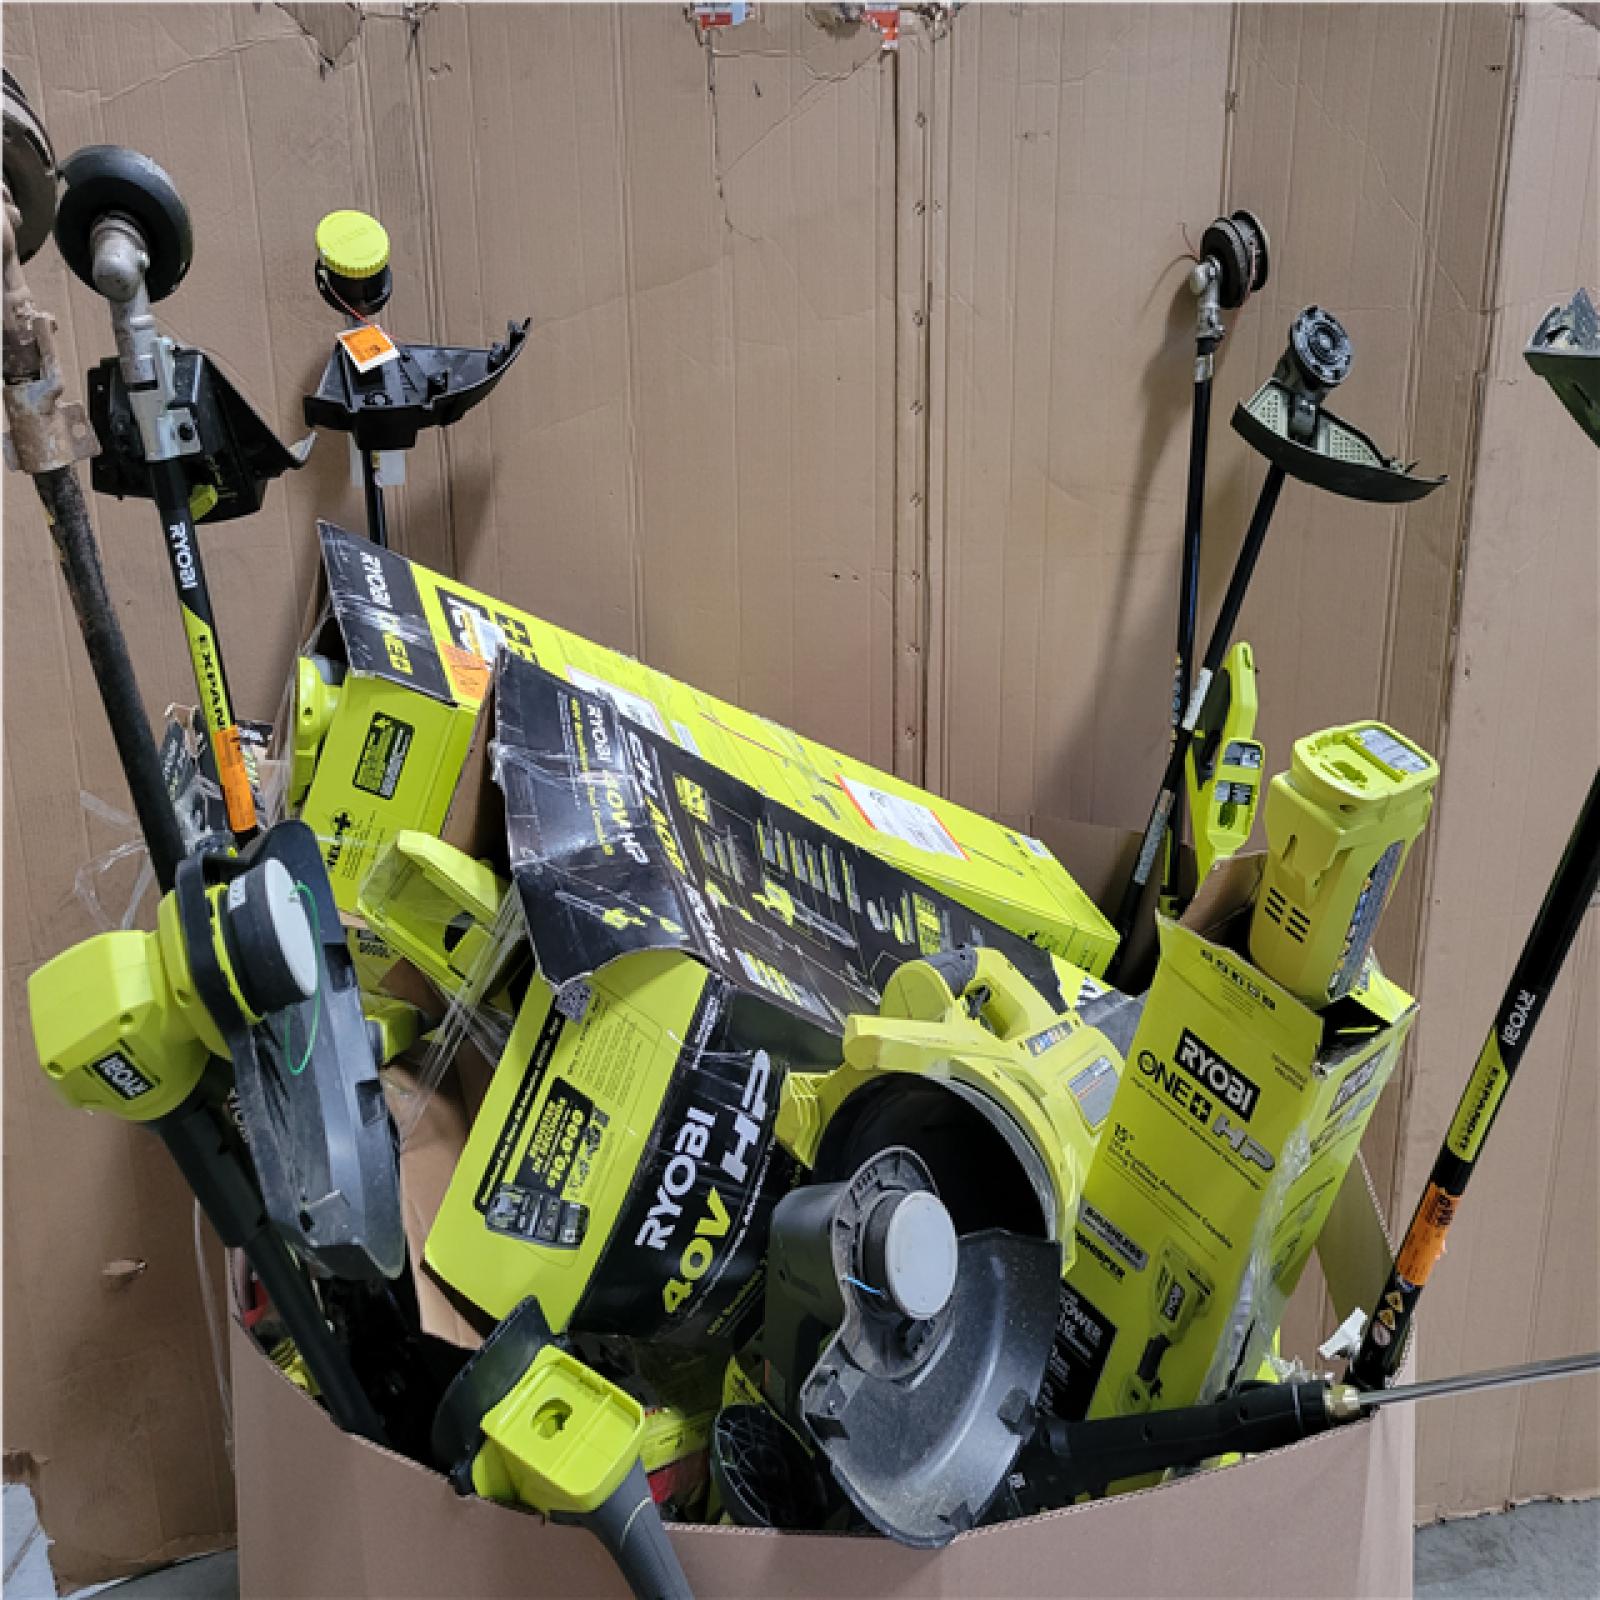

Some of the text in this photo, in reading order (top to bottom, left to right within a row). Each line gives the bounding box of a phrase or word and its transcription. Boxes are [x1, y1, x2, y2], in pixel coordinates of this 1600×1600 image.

[170, 521, 197, 589] RYOBI
[588, 704, 611, 761] RYOBI
[1500, 990, 1536, 1046] RYOBI
[101, 1054, 151, 1098] RYOBI
[1179, 1036, 1256, 1112] RYOBI
[719, 1049, 770, 1183] HP
[1212, 1114, 1276, 1172] HP
[635, 1107, 716, 1250] RYOBI
[662, 1187, 731, 1313] 40V
